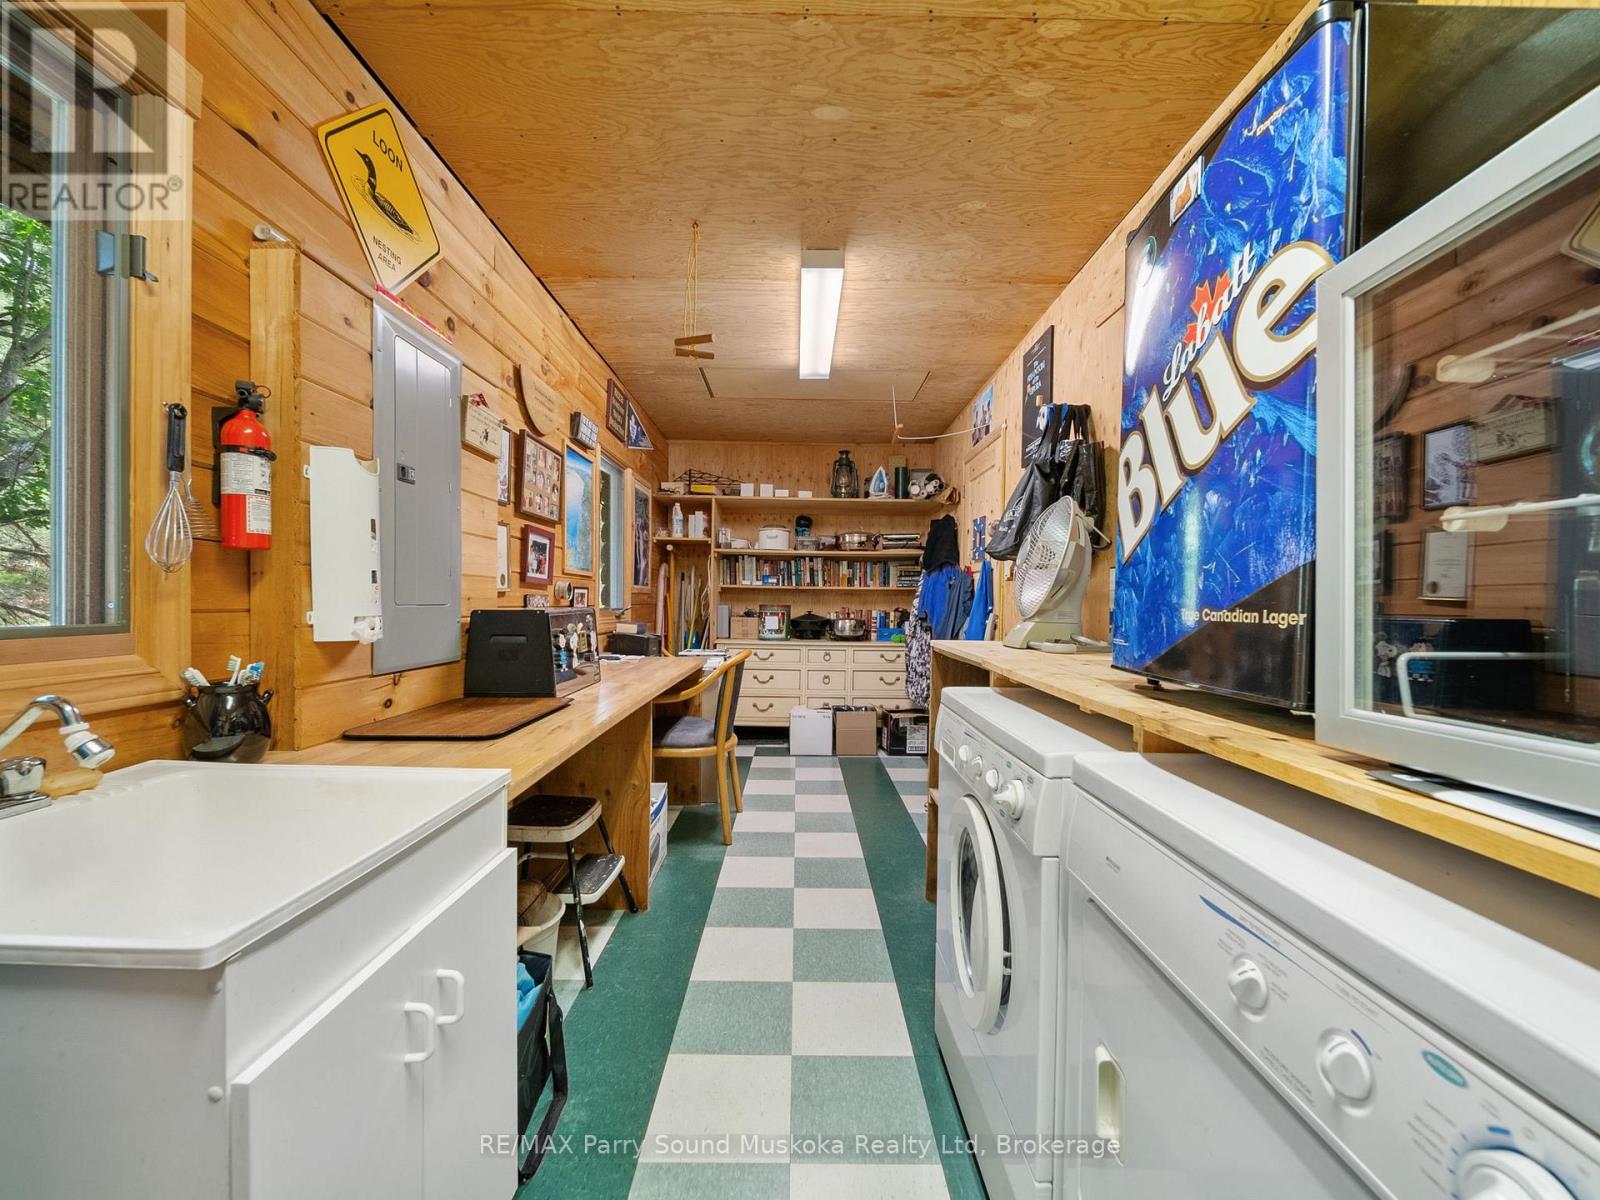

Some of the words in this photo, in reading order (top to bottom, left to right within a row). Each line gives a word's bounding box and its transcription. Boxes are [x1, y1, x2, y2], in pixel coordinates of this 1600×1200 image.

[372, 130, 403, 172] LOON
[372, 235, 402, 265] NESTING
[377, 254, 397, 272] AREA
[1162, 241, 1257, 402] Labatt
[1117, 240, 1335, 567] Blue
[1202, 608, 1259, 624] Canadian
[1262, 609, 1308, 629] Lager
